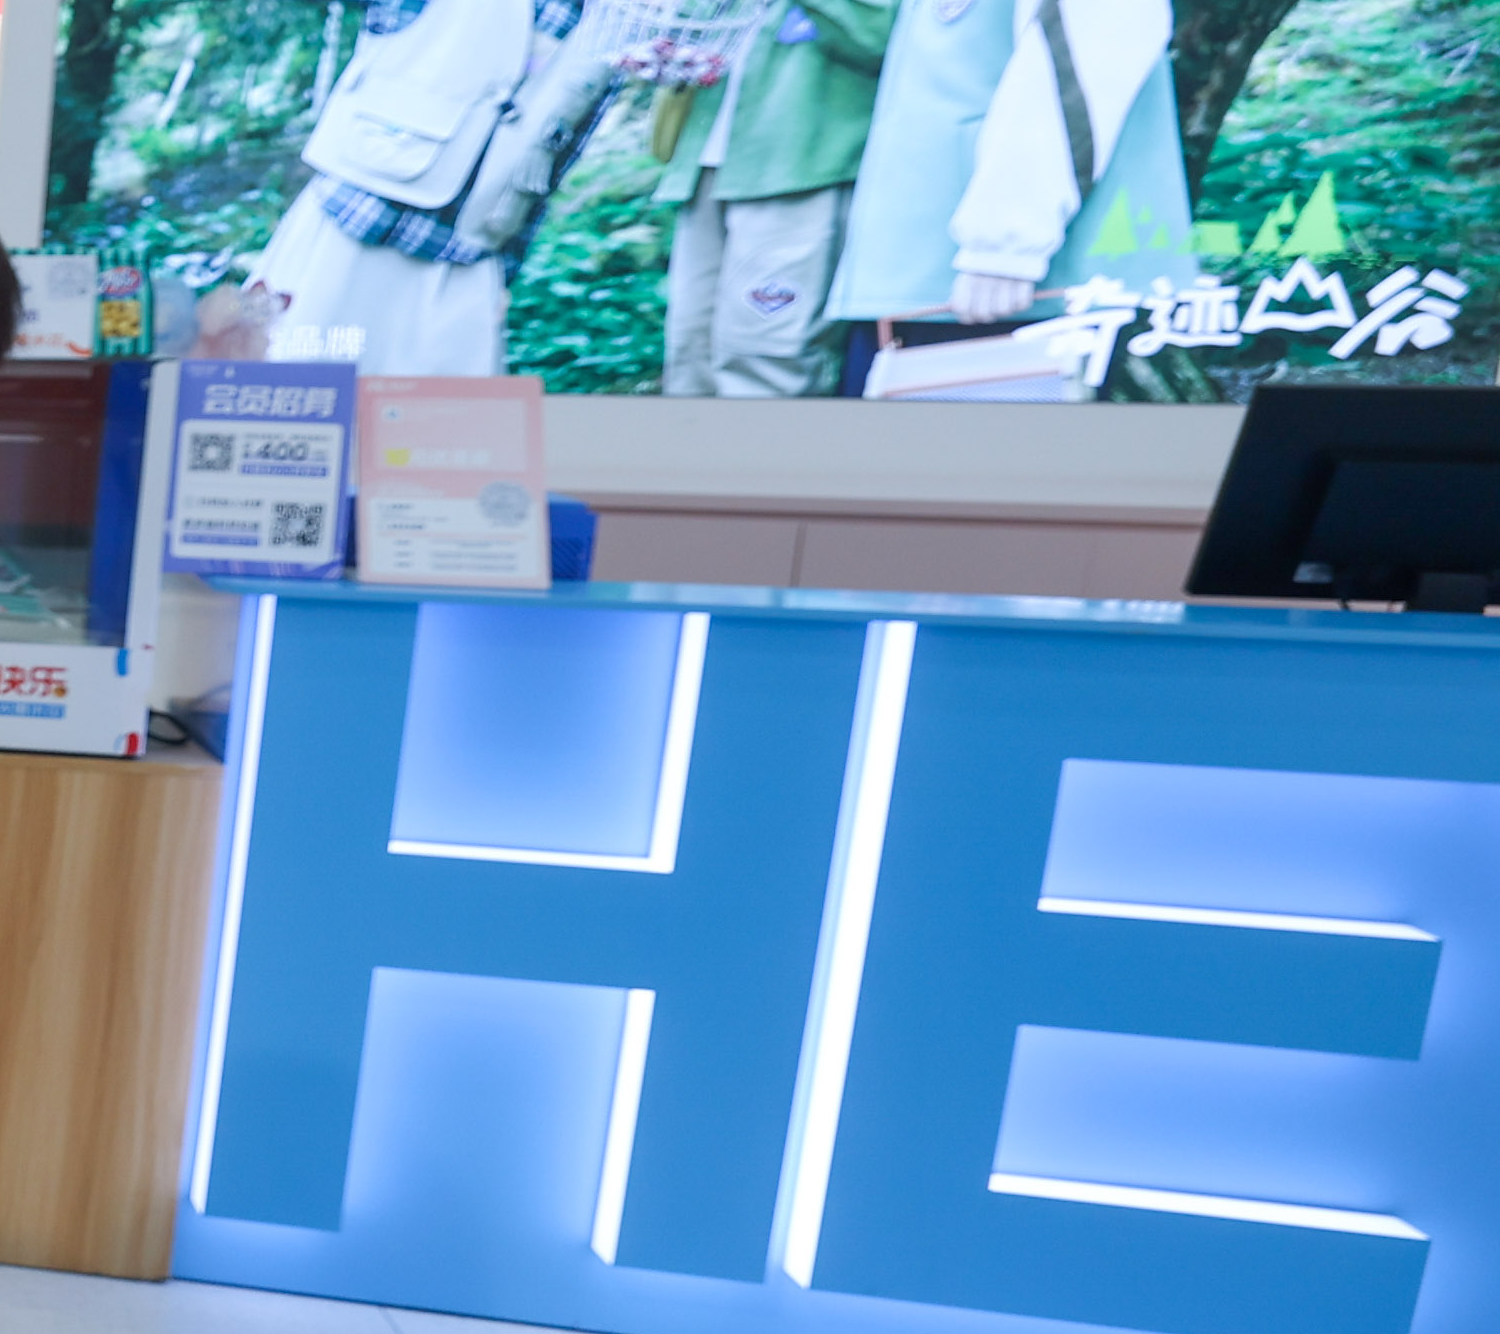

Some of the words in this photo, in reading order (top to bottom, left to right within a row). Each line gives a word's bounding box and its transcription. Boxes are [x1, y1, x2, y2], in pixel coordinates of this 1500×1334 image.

[1011, 257, 1470, 388] 奇迹山谷
[257, 442, 310, 461] 400
